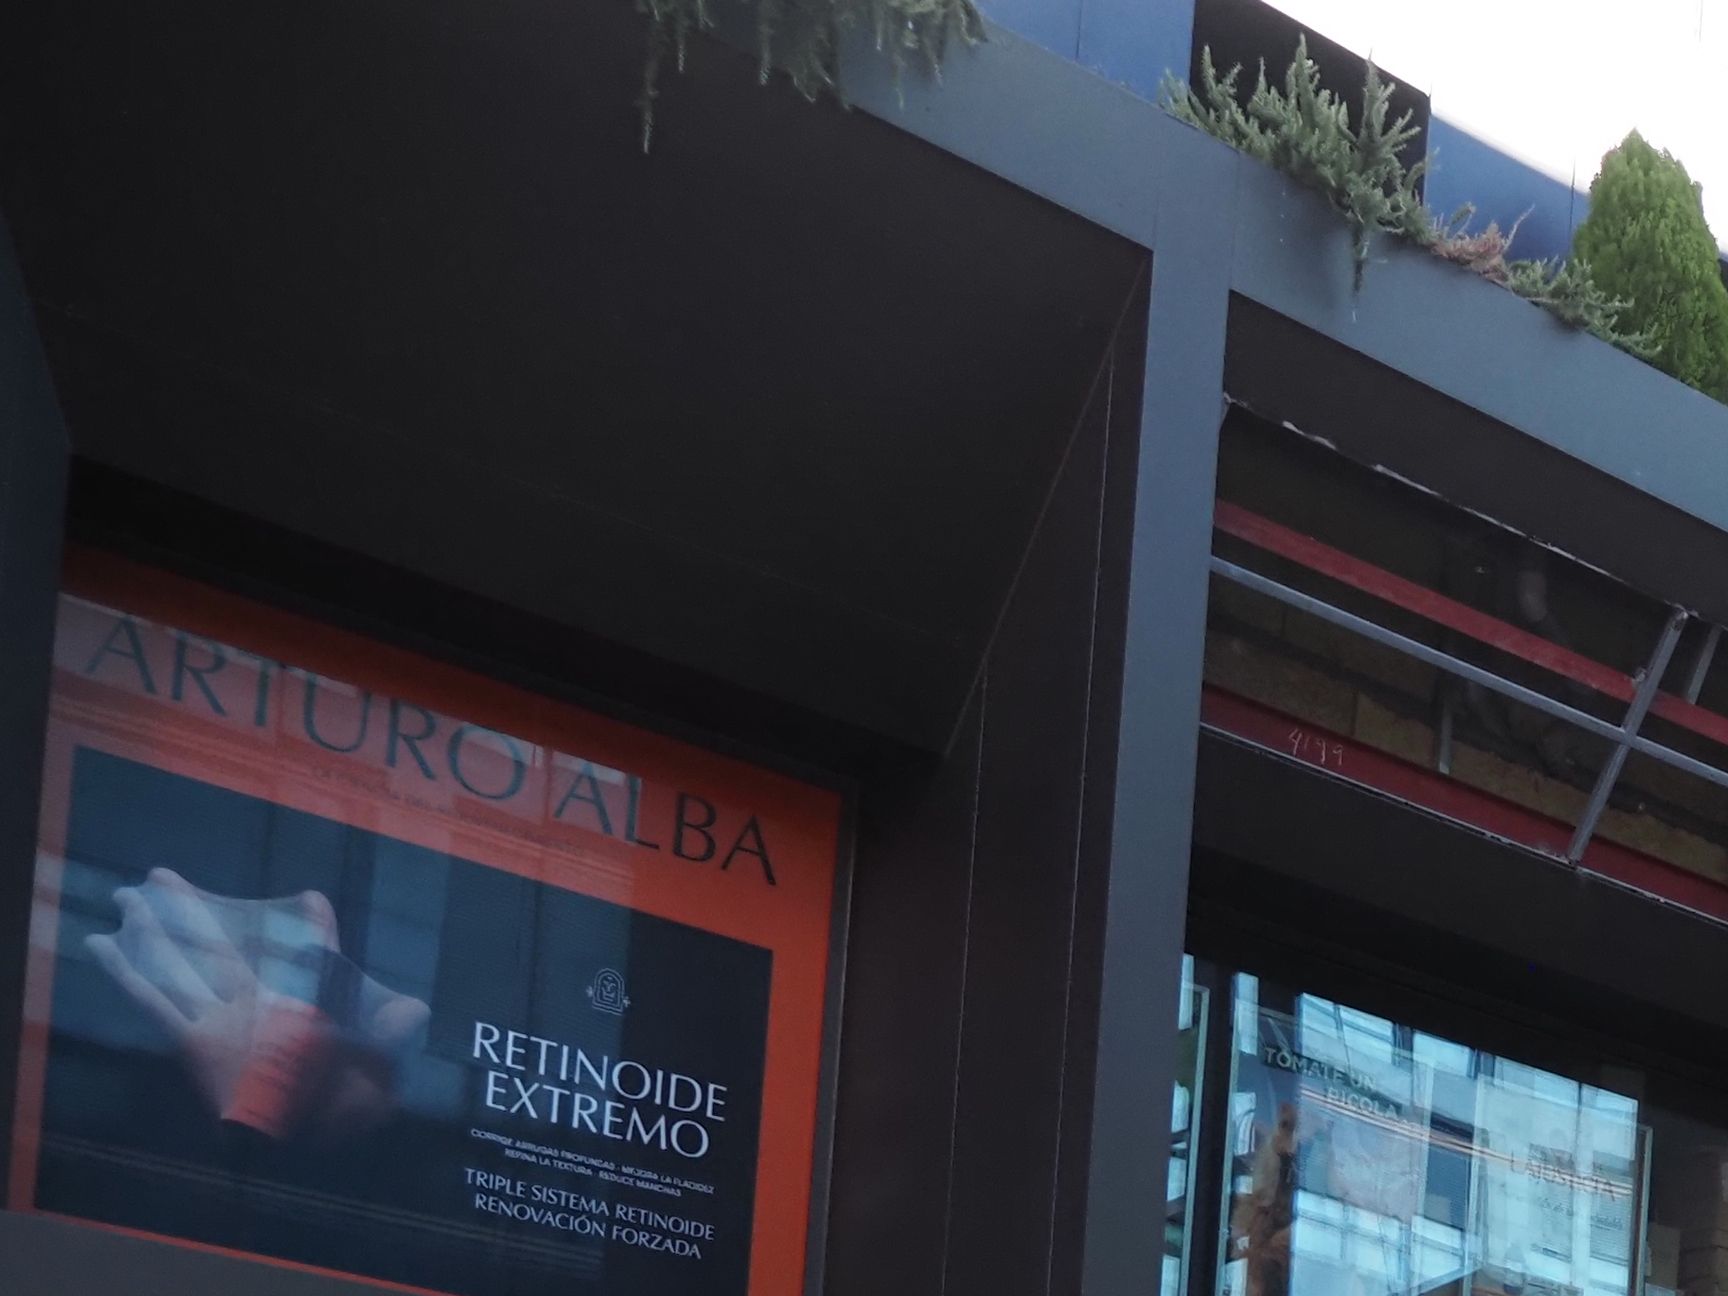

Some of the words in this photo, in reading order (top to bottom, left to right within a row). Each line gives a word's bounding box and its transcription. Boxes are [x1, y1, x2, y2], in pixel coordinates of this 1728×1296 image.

[86, 613, 526, 801] ARTURO
[555, 756, 778, 887] ALBA
[473, 1021, 727, 1121] RETINOIDE
[486, 1070, 709, 1158] EXTREMO
[465, 1167, 527, 1198] TRIPLE
[531, 1184, 610, 1217] SISTEMA
[615, 1203, 716, 1241] RETINOIDE
[475, 1194, 607, 1238] RENOVACIÓN
[612, 1225, 702, 1259] FORZADA
